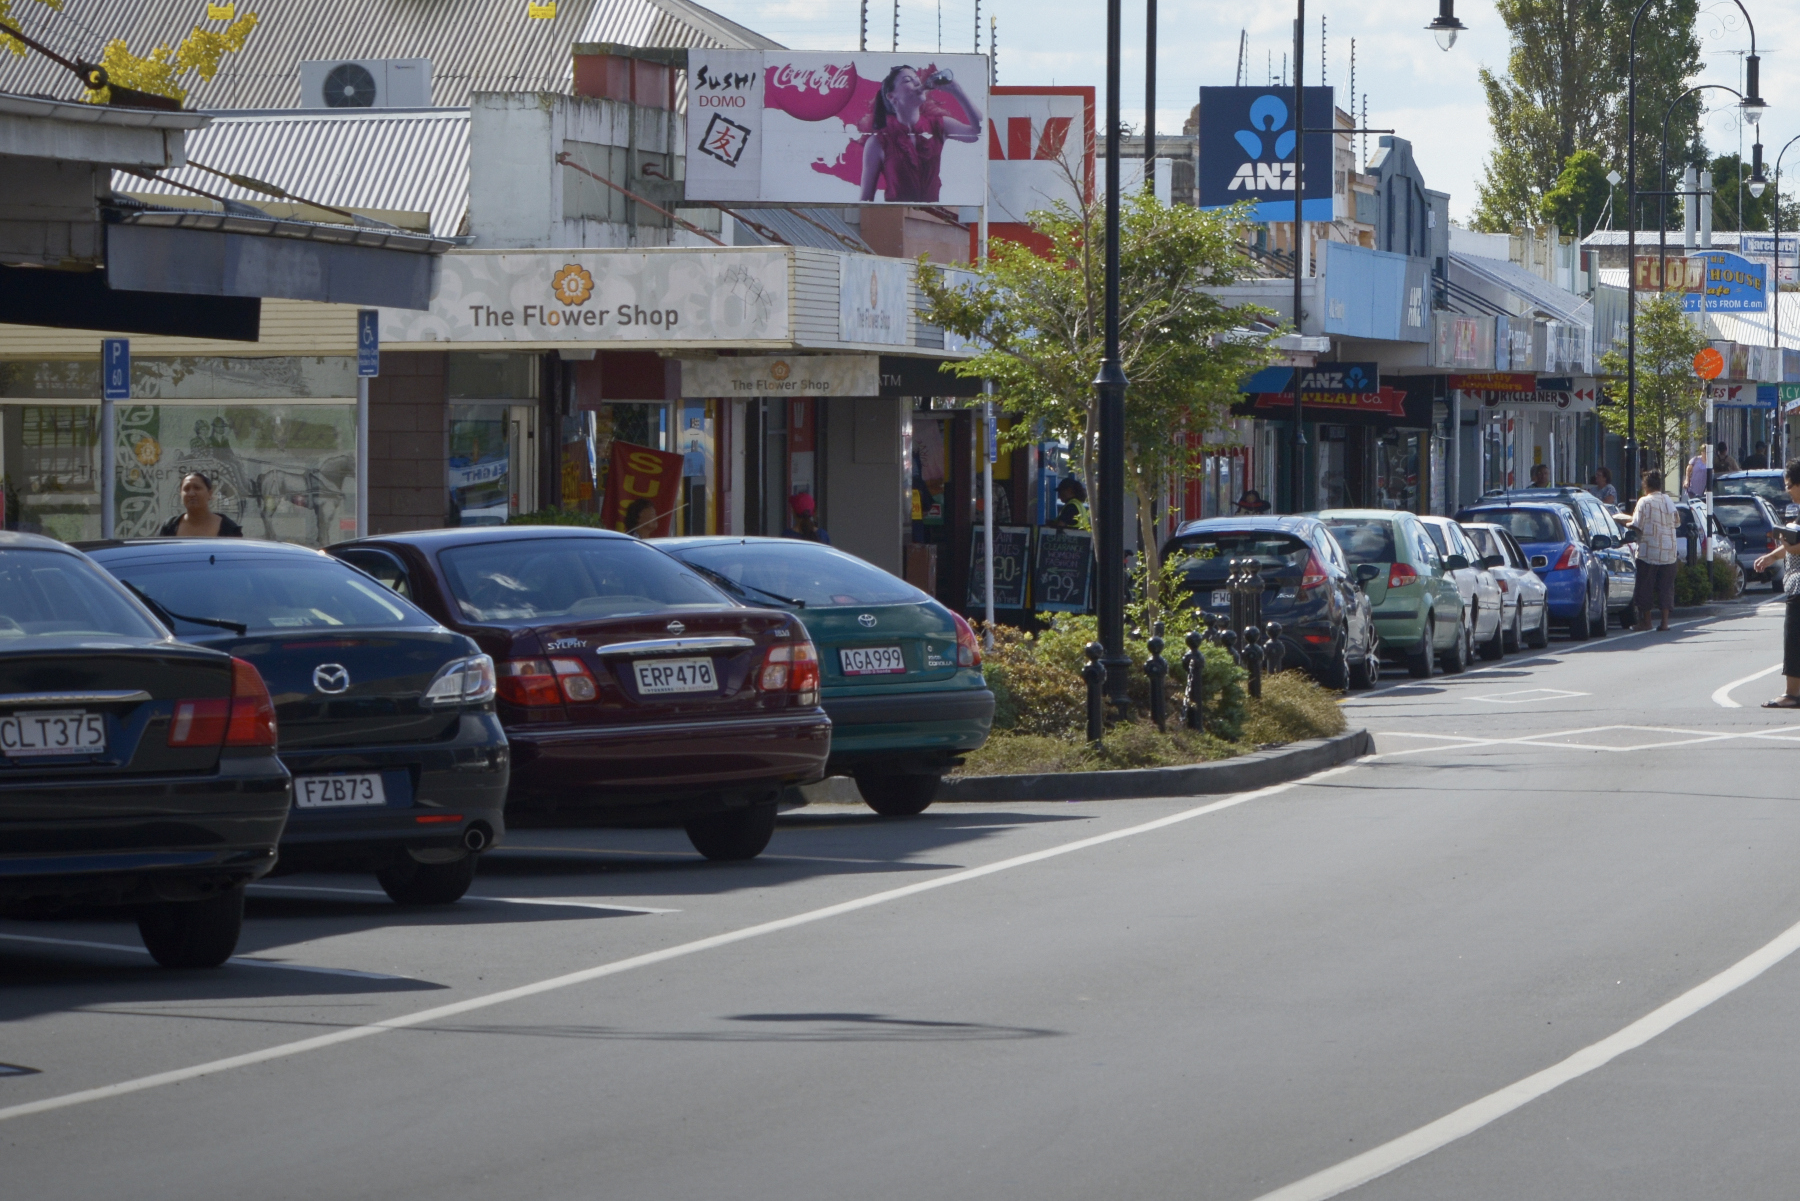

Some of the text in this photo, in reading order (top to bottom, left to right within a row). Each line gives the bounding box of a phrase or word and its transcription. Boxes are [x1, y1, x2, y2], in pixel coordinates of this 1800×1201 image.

[699, 95, 746, 108] DOMO
[1227, 162, 1306, 190] ANZ
[1634, 260, 1701, 288] FOOD
[1706, 268, 1762, 291] HOUSE
[1706, 286, 1730, 296] afe
[1719, 300, 1742, 308] FROM
[469, 304, 679, 330] The Flower Shop
[112, 342, 121, 364] P
[112, 368, 122, 386] 60
[732, 380, 830, 392] The Flower Shop
[1300, 372, 1344, 388] ANZ
[1458, 380, 1523, 390] Jewellers
[1362, 392, 1382, 404] Co.
[1484, 390, 1572, 410] DRYCLEANERS
[78, 464, 100, 480] Th
[114, 464, 173, 480] Flower
[547, 638, 588, 650] SYLPHY
[844, 650, 901, 670] AGA999
[638, 664, 713, 688] ERP470
[0, 715, 103, 749] CLT375
[304, 778, 375, 804] FZB73
